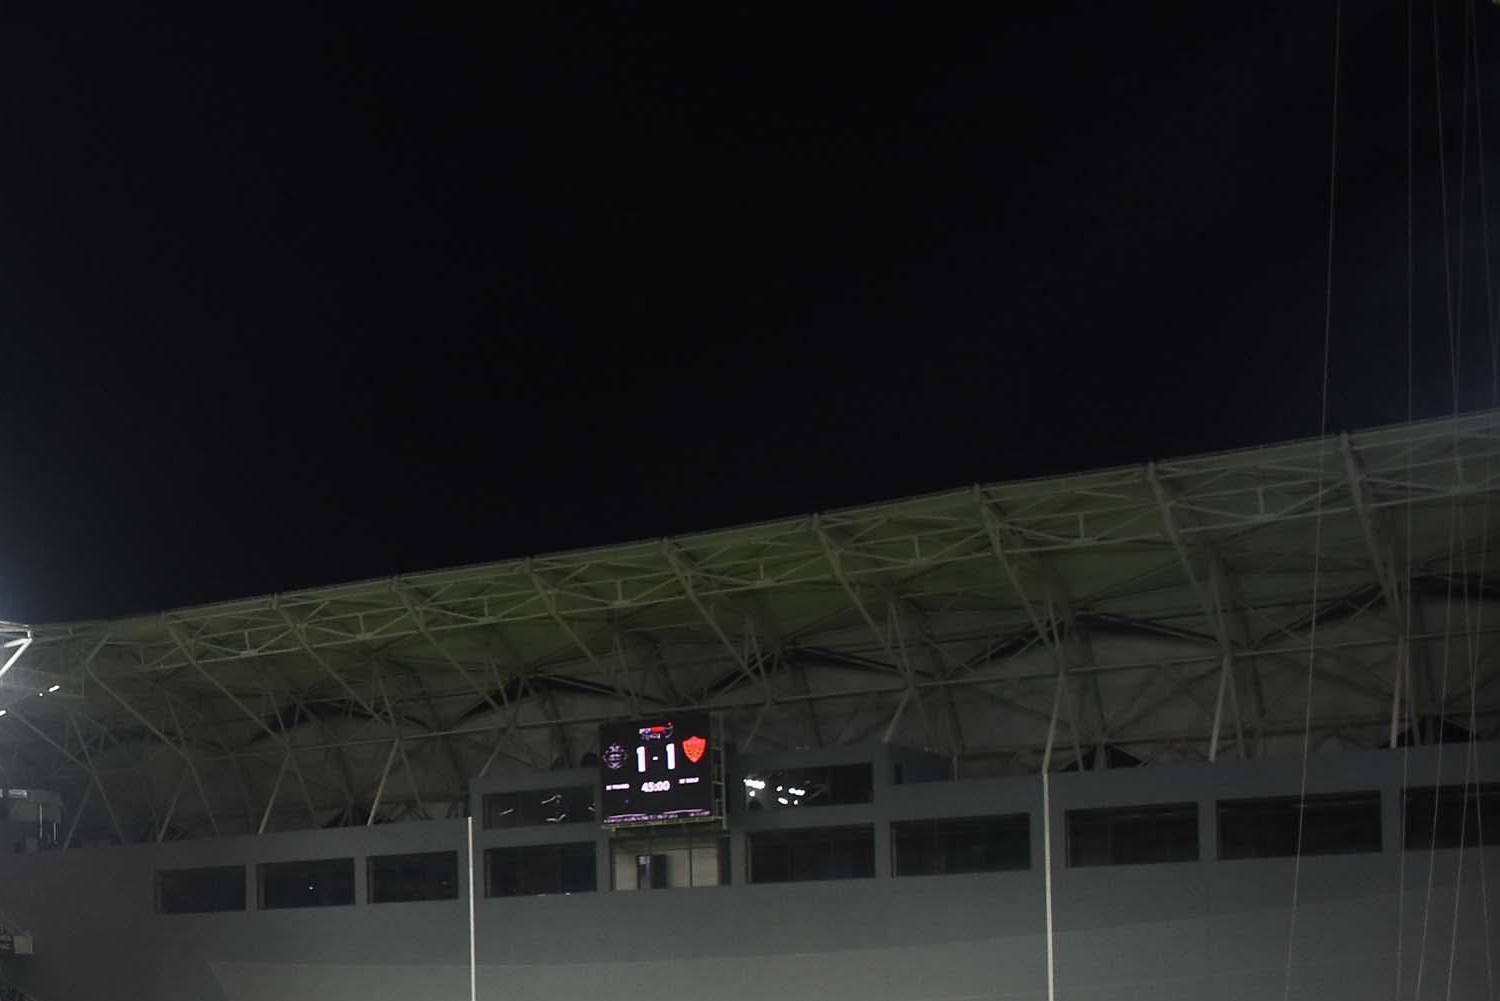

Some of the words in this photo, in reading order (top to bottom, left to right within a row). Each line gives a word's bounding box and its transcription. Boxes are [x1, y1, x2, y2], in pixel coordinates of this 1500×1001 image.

[636, 745, 646, 772] 1
[666, 743, 676, 770] 1
[641, 780, 671, 793] 45:00
